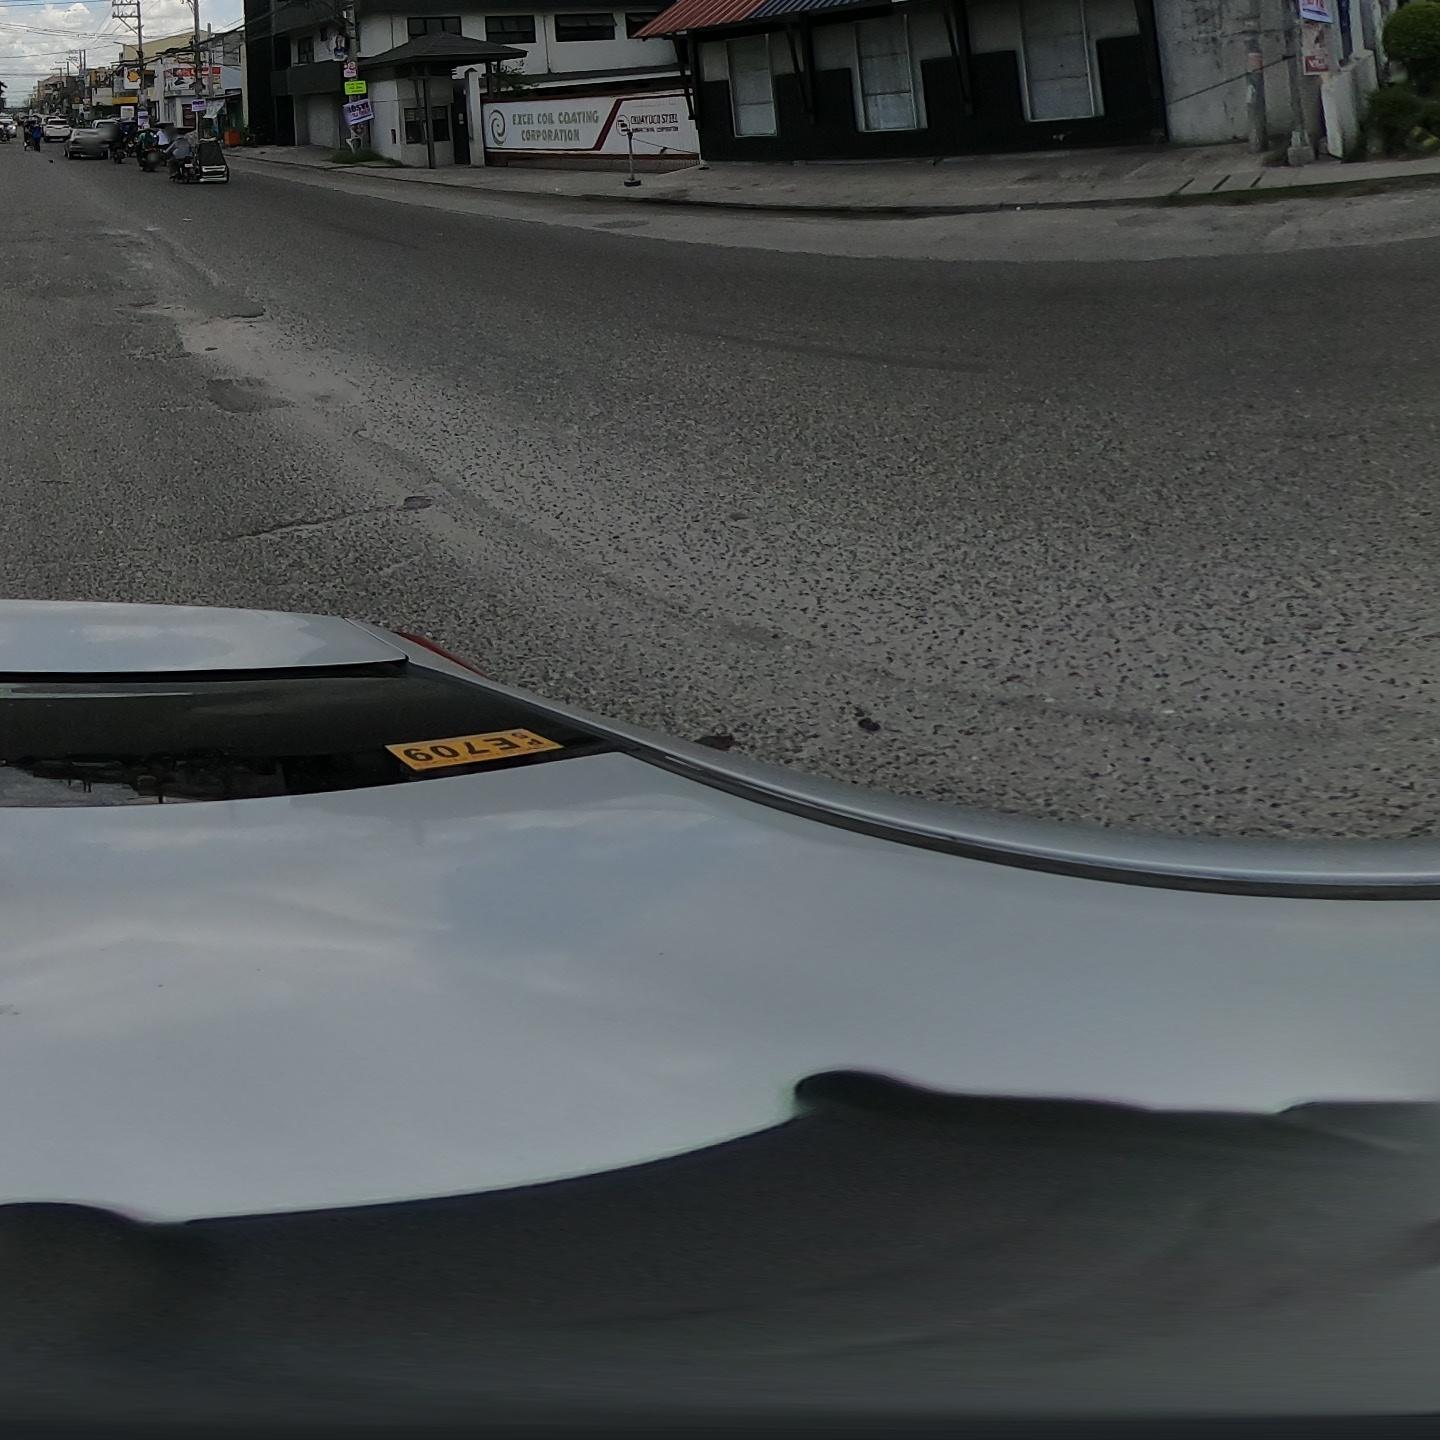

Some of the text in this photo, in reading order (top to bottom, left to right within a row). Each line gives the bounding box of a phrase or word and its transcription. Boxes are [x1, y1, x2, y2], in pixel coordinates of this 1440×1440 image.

[512, 110, 599, 126] EXCEL COIL COATING
[521, 128, 580, 143] CORPORATION
[403, 736, 521, 763] E709
